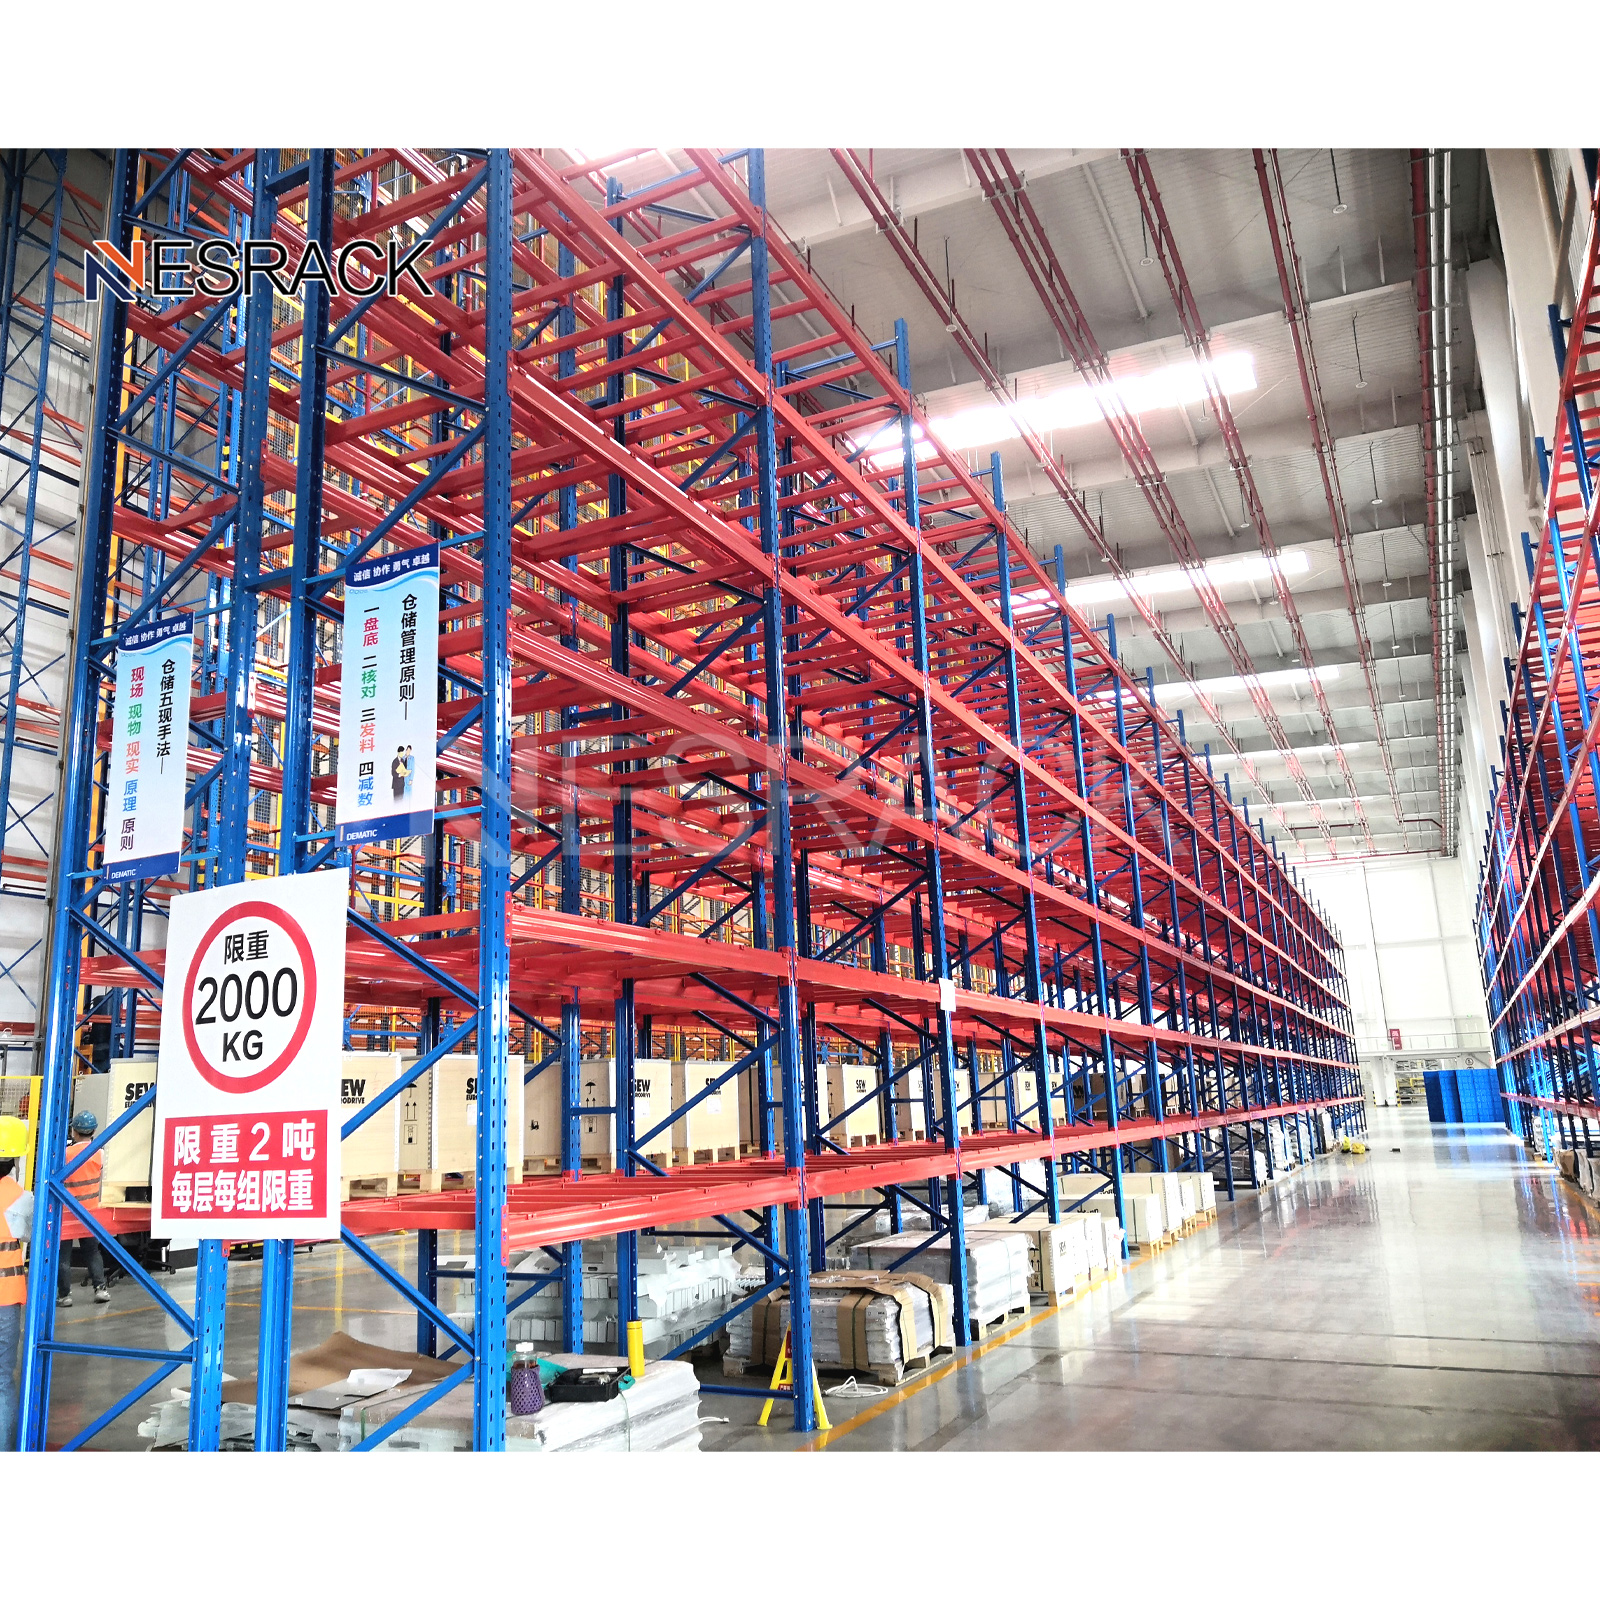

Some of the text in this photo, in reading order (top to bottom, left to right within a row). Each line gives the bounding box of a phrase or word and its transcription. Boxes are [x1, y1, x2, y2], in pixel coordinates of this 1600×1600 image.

[353, 553, 430, 582] 诚信 协作 勇气 卓越
[357, 606, 380, 808] 一盘底 二核对 三发料 四减数
[120, 666, 145, 851] 现场 现物 现实 原理 原则
[346, 829, 378, 841] DEMATIC
[111, 868, 137, 880] DEMATIC
[224, 930, 270, 965] 限重
[195, 967, 298, 1026] 2000
[222, 1029, 264, 1063] KG
[341, 1079, 366, 1097] EW
[341, 1097, 366, 1105] ODRIVE
[171, 1168, 314, 1213] 每层每组限重
